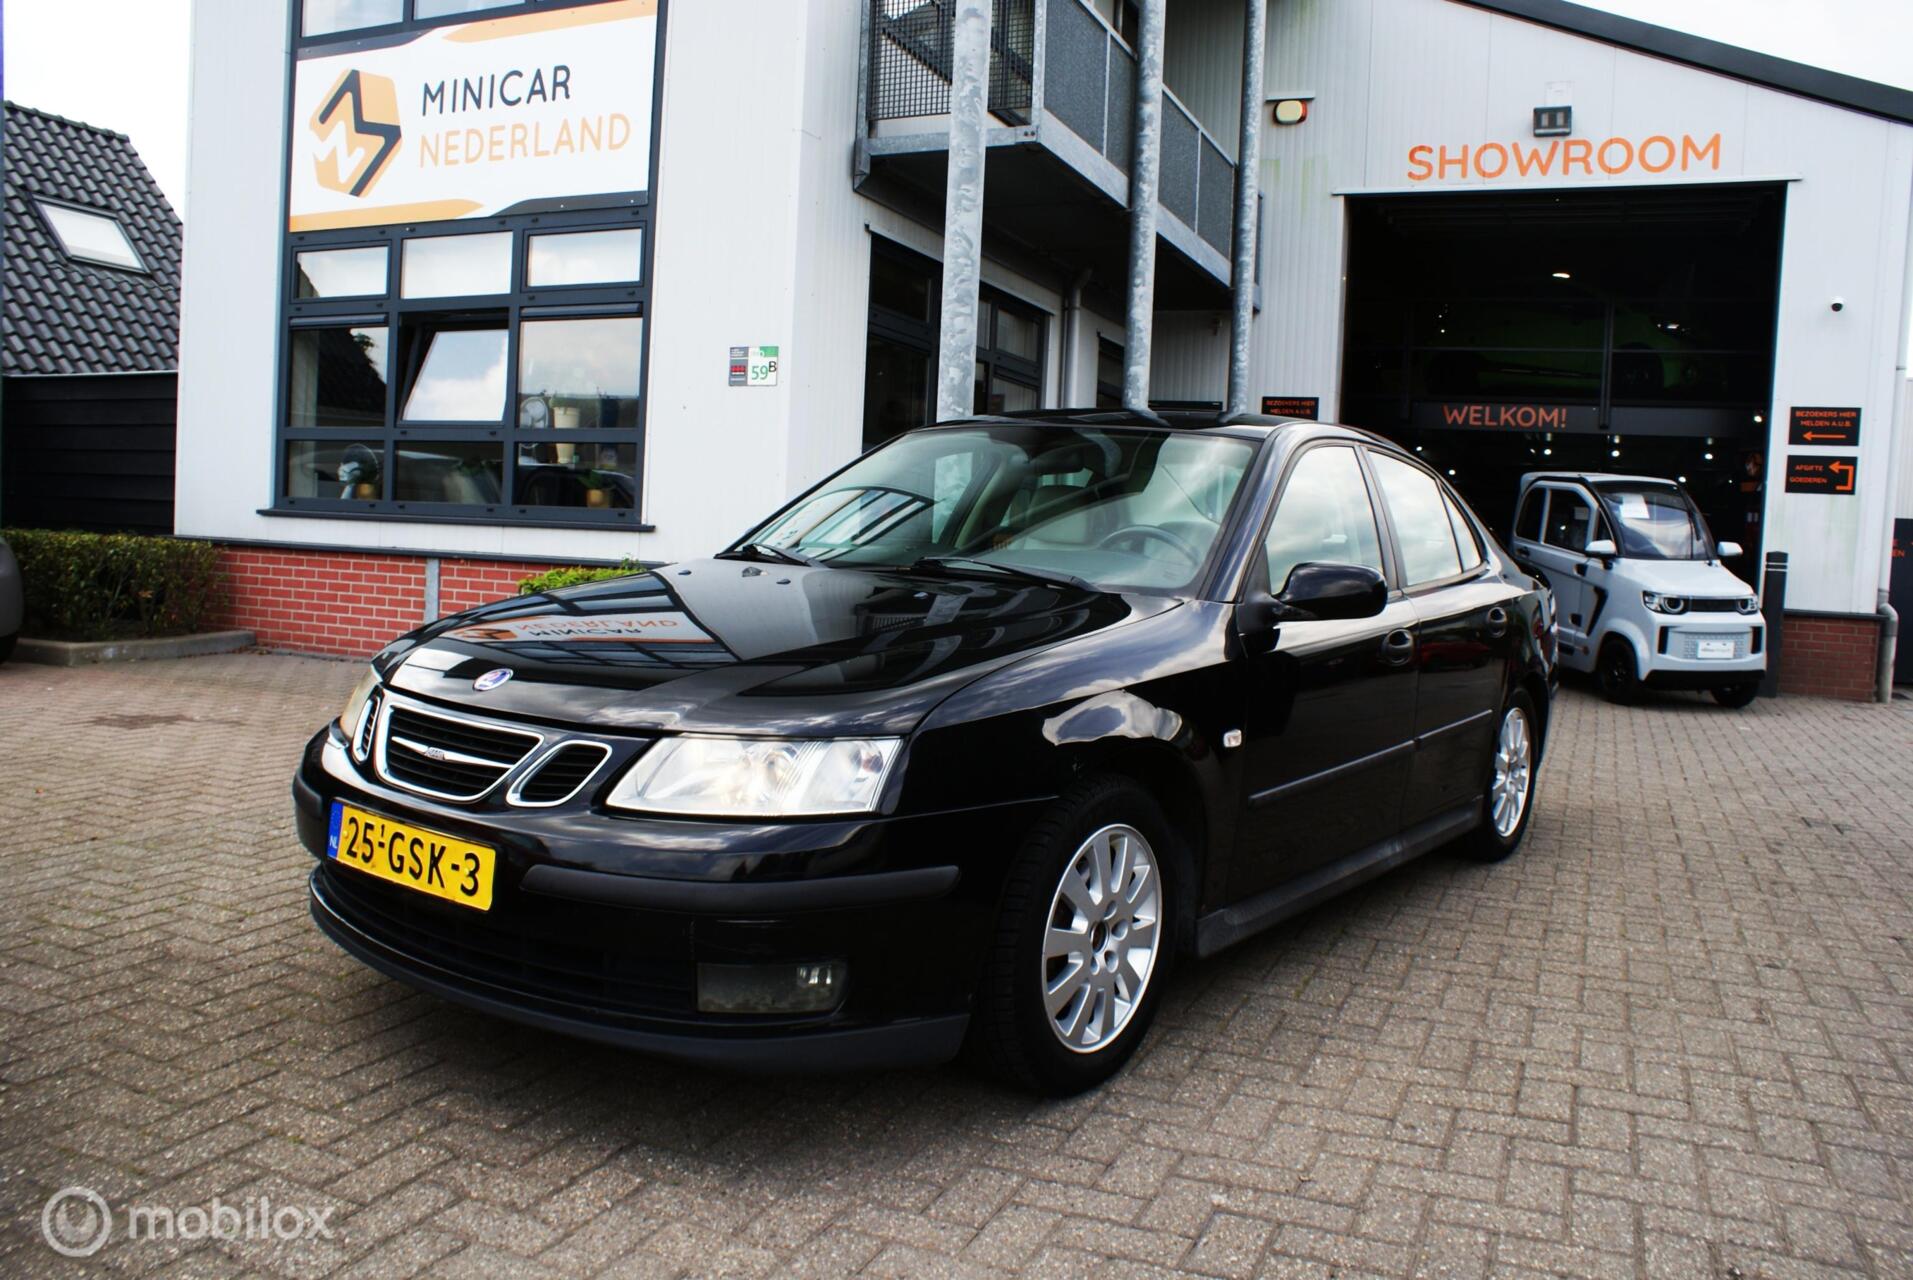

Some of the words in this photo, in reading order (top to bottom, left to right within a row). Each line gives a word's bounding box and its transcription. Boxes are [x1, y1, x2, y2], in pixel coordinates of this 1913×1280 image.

[421, 64, 571, 117] MINICAR
[419, 112, 631, 168] NEDERLAND
[1407, 133, 1721, 181] SHOWROOM
[1442, 404, 1567, 428] WELKOM!
[1795, 410, 1838, 418] BEZOEKERS
